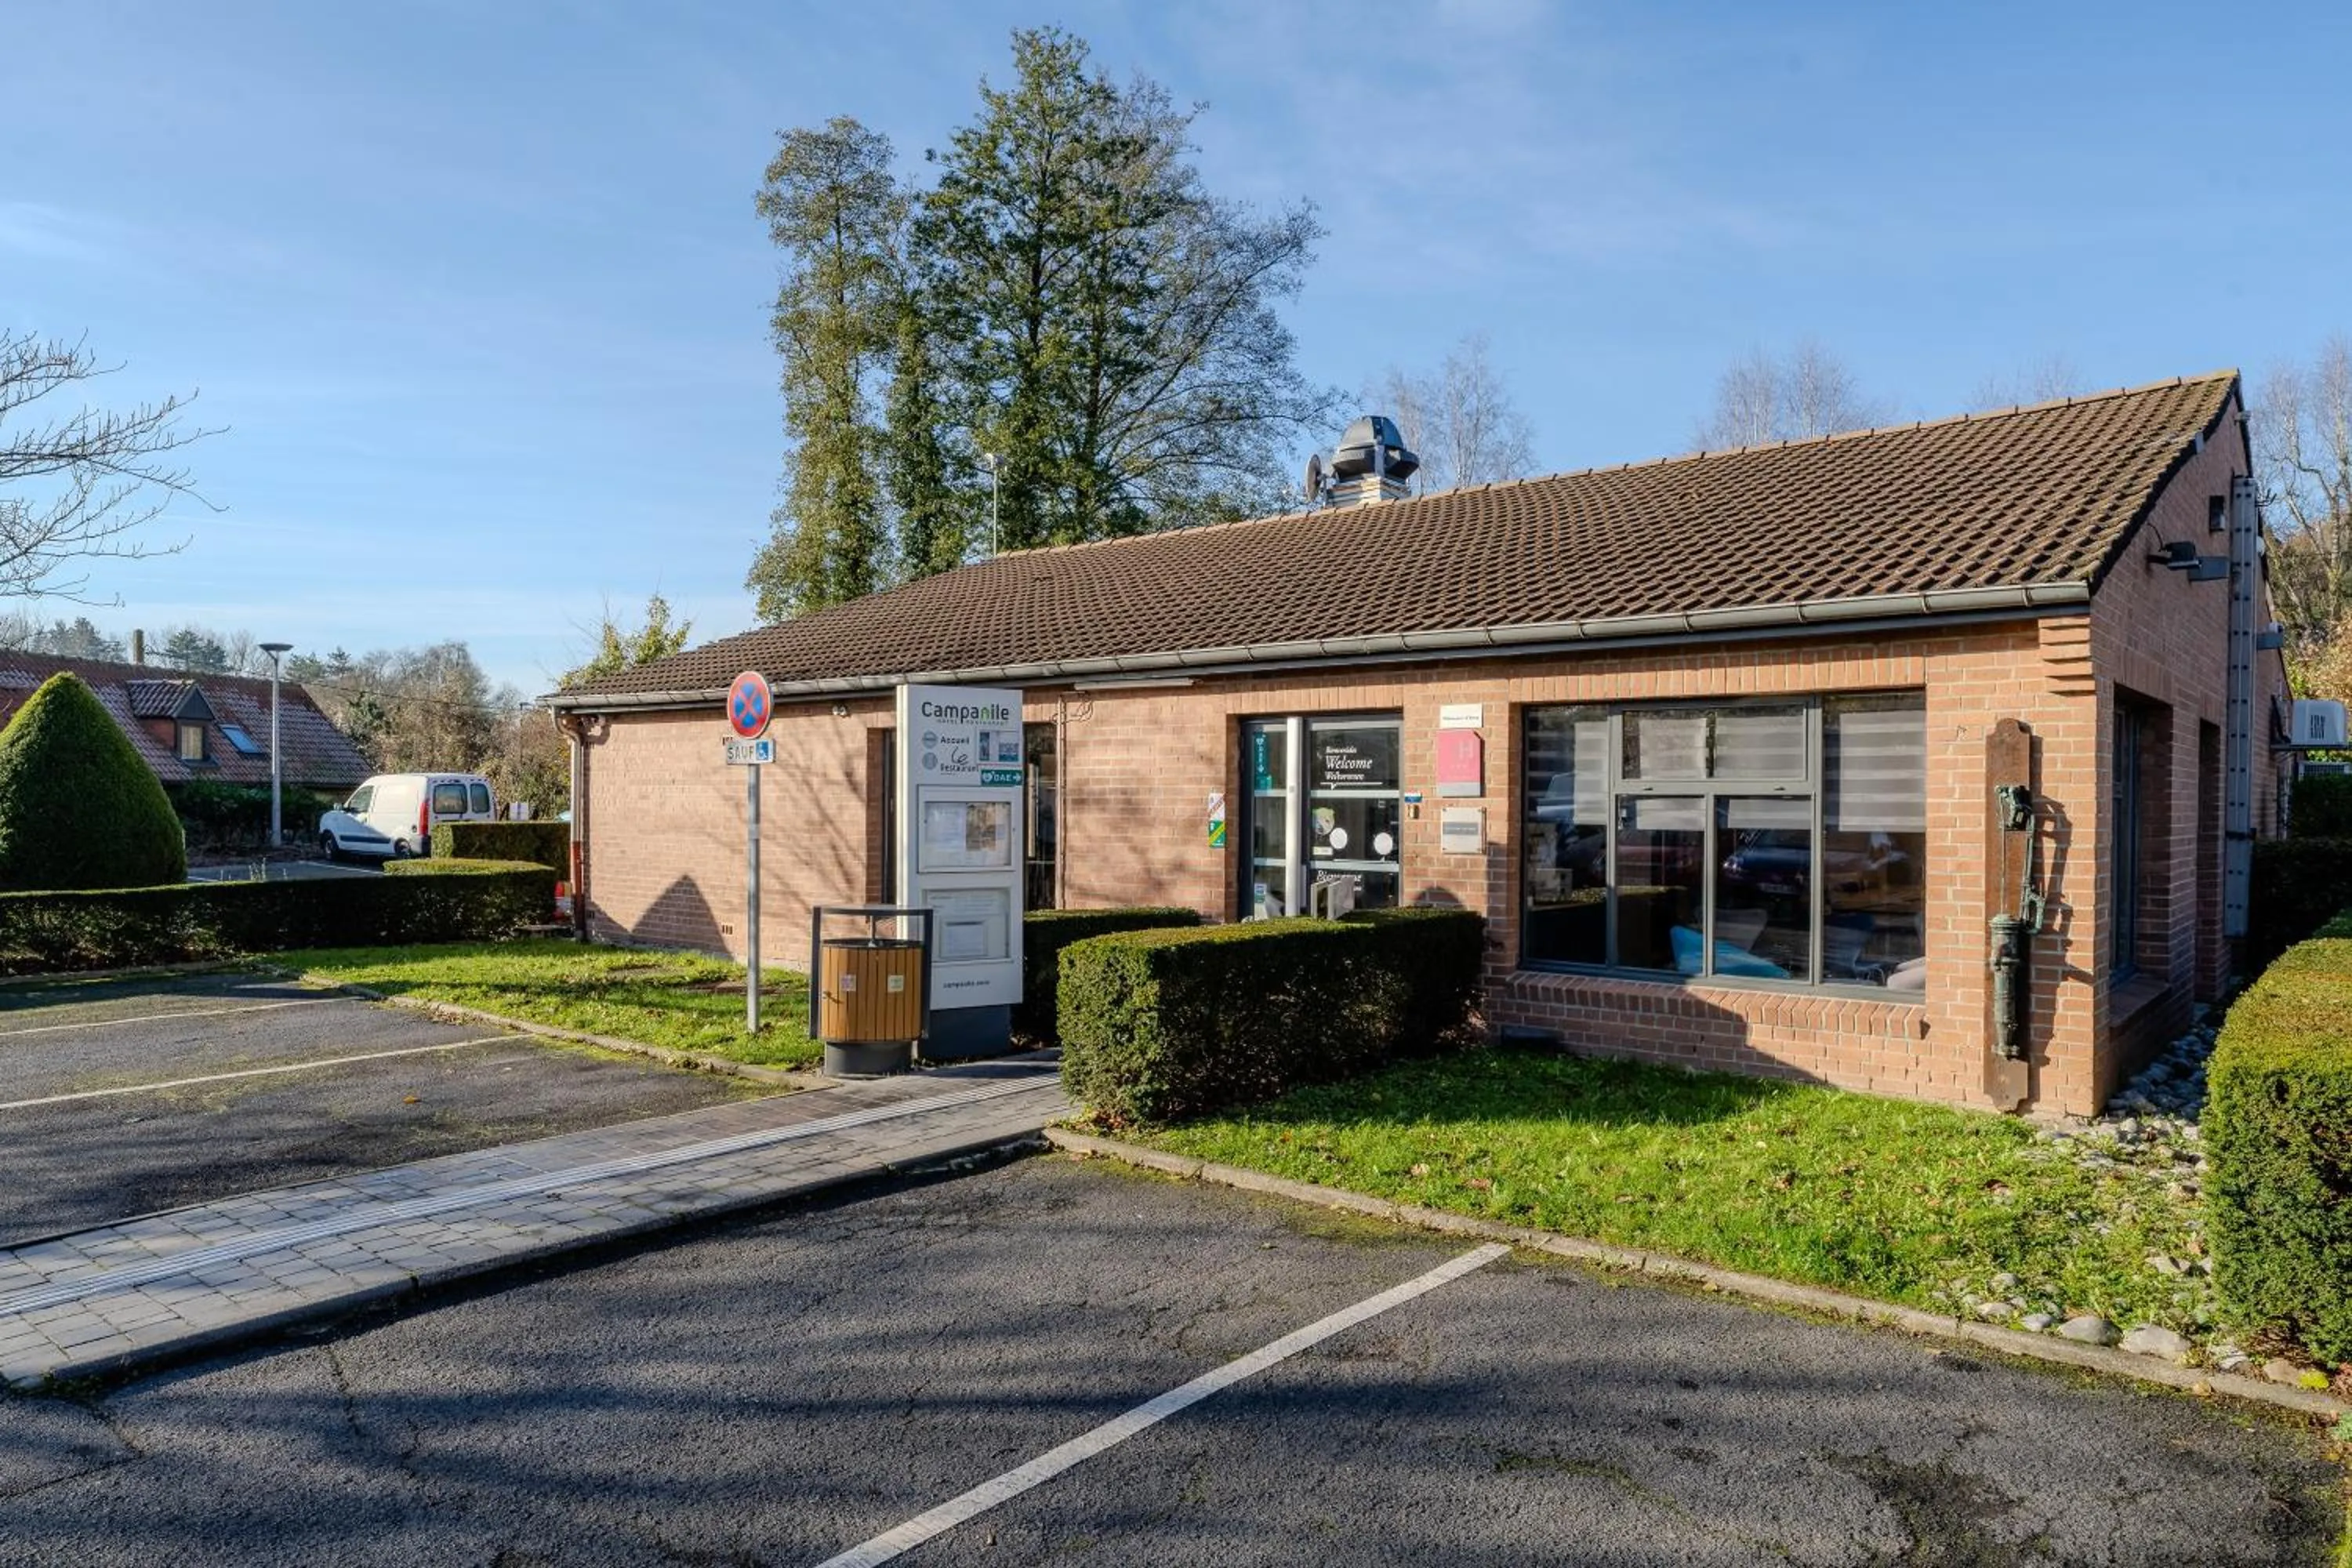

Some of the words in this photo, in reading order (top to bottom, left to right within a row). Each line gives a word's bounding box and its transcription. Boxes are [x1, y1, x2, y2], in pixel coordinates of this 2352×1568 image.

[921, 702, 1010, 724] Campanile
[728, 746, 754, 760] SAUF
[1326, 755, 1373, 769] Welcome
[993, 774, 1012, 782] DAE
